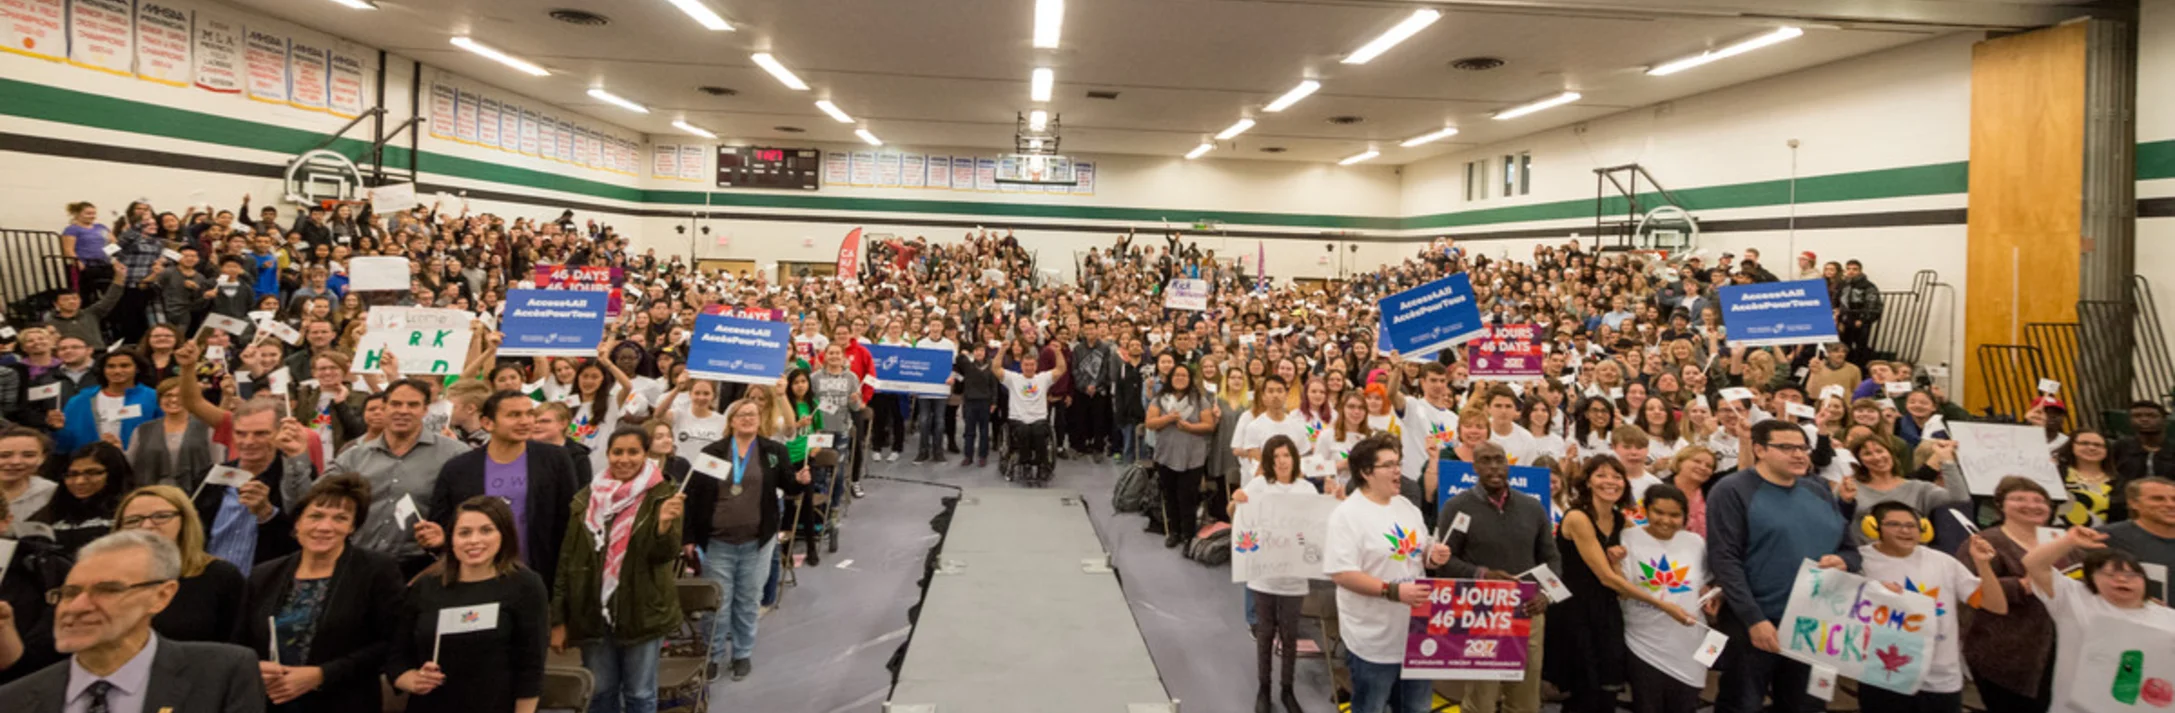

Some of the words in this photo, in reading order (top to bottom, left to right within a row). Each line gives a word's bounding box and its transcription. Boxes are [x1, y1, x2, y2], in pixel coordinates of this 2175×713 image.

[551, 268, 569, 281] 46
[572, 269, 610, 281] DAYS
[1399, 286, 1453, 310] Access4All
[1741, 288, 1806, 301] Access4All
[526, 298, 589, 308] Access4All
[713, 323, 772, 338] Access4All
[1495, 327, 1535, 339] JOURS
[1480, 341, 1497, 352] 46
[1499, 341, 1531, 352] DAYS
[1428, 586, 1453, 604] 46
[1456, 587, 1522, 606] JOURS
[1430, 610, 1455, 628] 46
[1461, 611, 1512, 629] DAYS
[1790, 615, 1872, 663] RICK!
[1464, 640, 1498, 654] 2017
